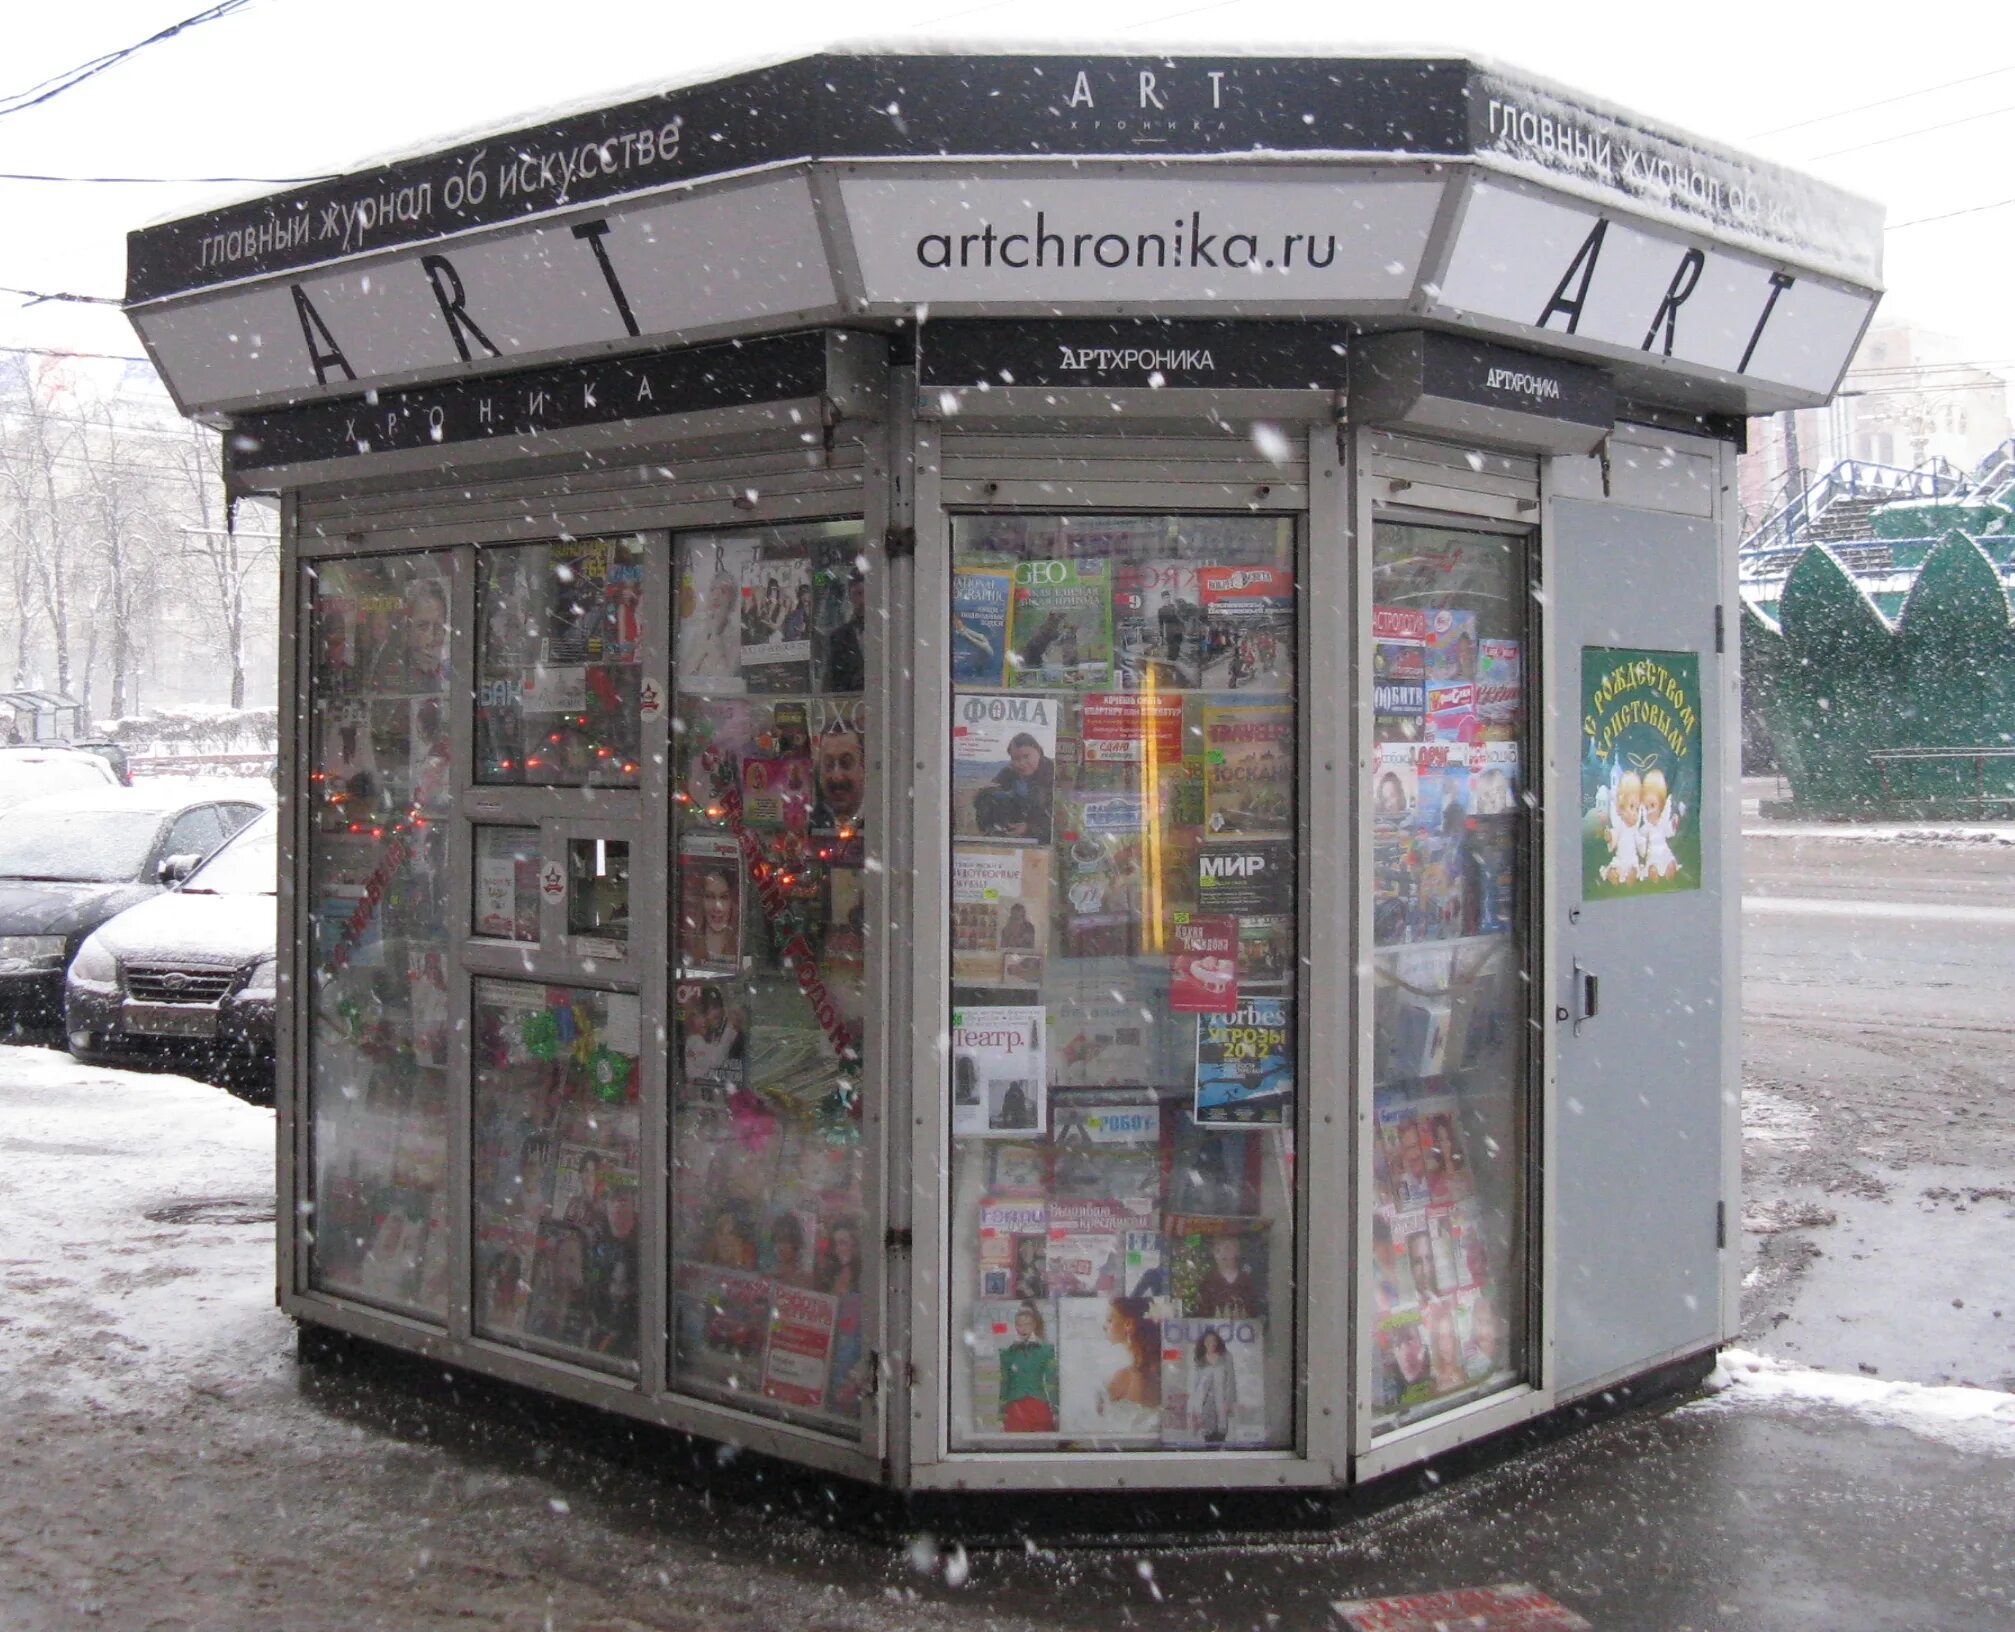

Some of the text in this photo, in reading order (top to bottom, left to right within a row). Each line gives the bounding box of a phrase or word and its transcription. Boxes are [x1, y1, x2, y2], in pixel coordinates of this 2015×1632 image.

[1070, 70, 1227, 111] ART
[201, 118, 681, 268] главный журнал об искусстве
[915, 210, 1338, 270] artchronika.ru
[290, 218, 642, 386] ART
[1535, 218, 1796, 374] ART
[1059, 346, 1216, 372] АРТХРОНИКА
[1014, 560, 1067, 585] GEO
[962, 698, 1048, 726] ФОМА
[1200, 856, 1266, 878] МИР
[953, 1028, 1026, 1054] Театр.
[1222, 1042, 1269, 1058] 2012
[1162, 1319, 1256, 1344] burda
